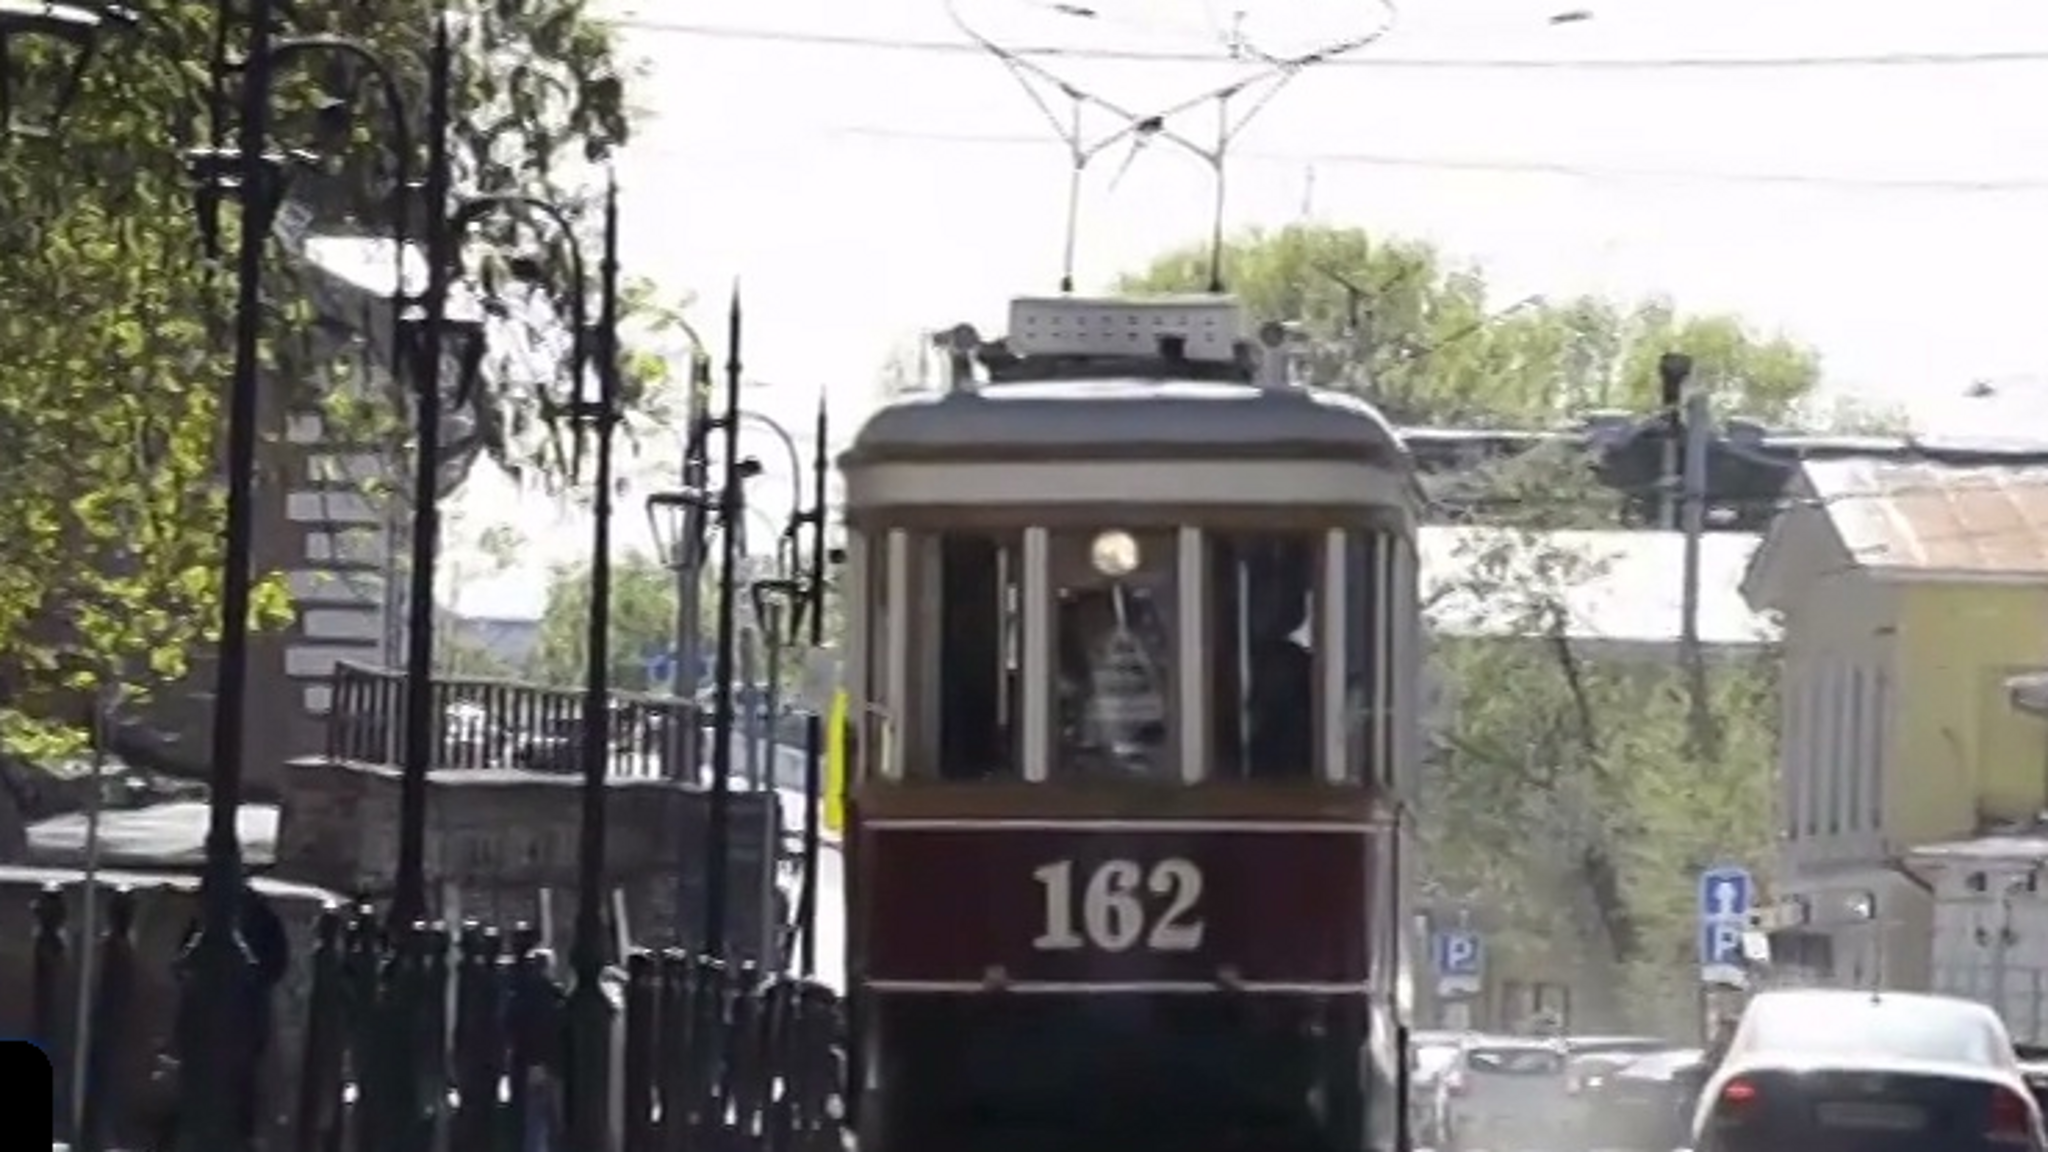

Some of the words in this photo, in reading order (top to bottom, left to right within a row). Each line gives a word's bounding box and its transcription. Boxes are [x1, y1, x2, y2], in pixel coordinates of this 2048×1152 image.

[1032, 858, 1204, 952] 162
[1448, 937, 1472, 969] P
[1715, 926, 1739, 961] P
